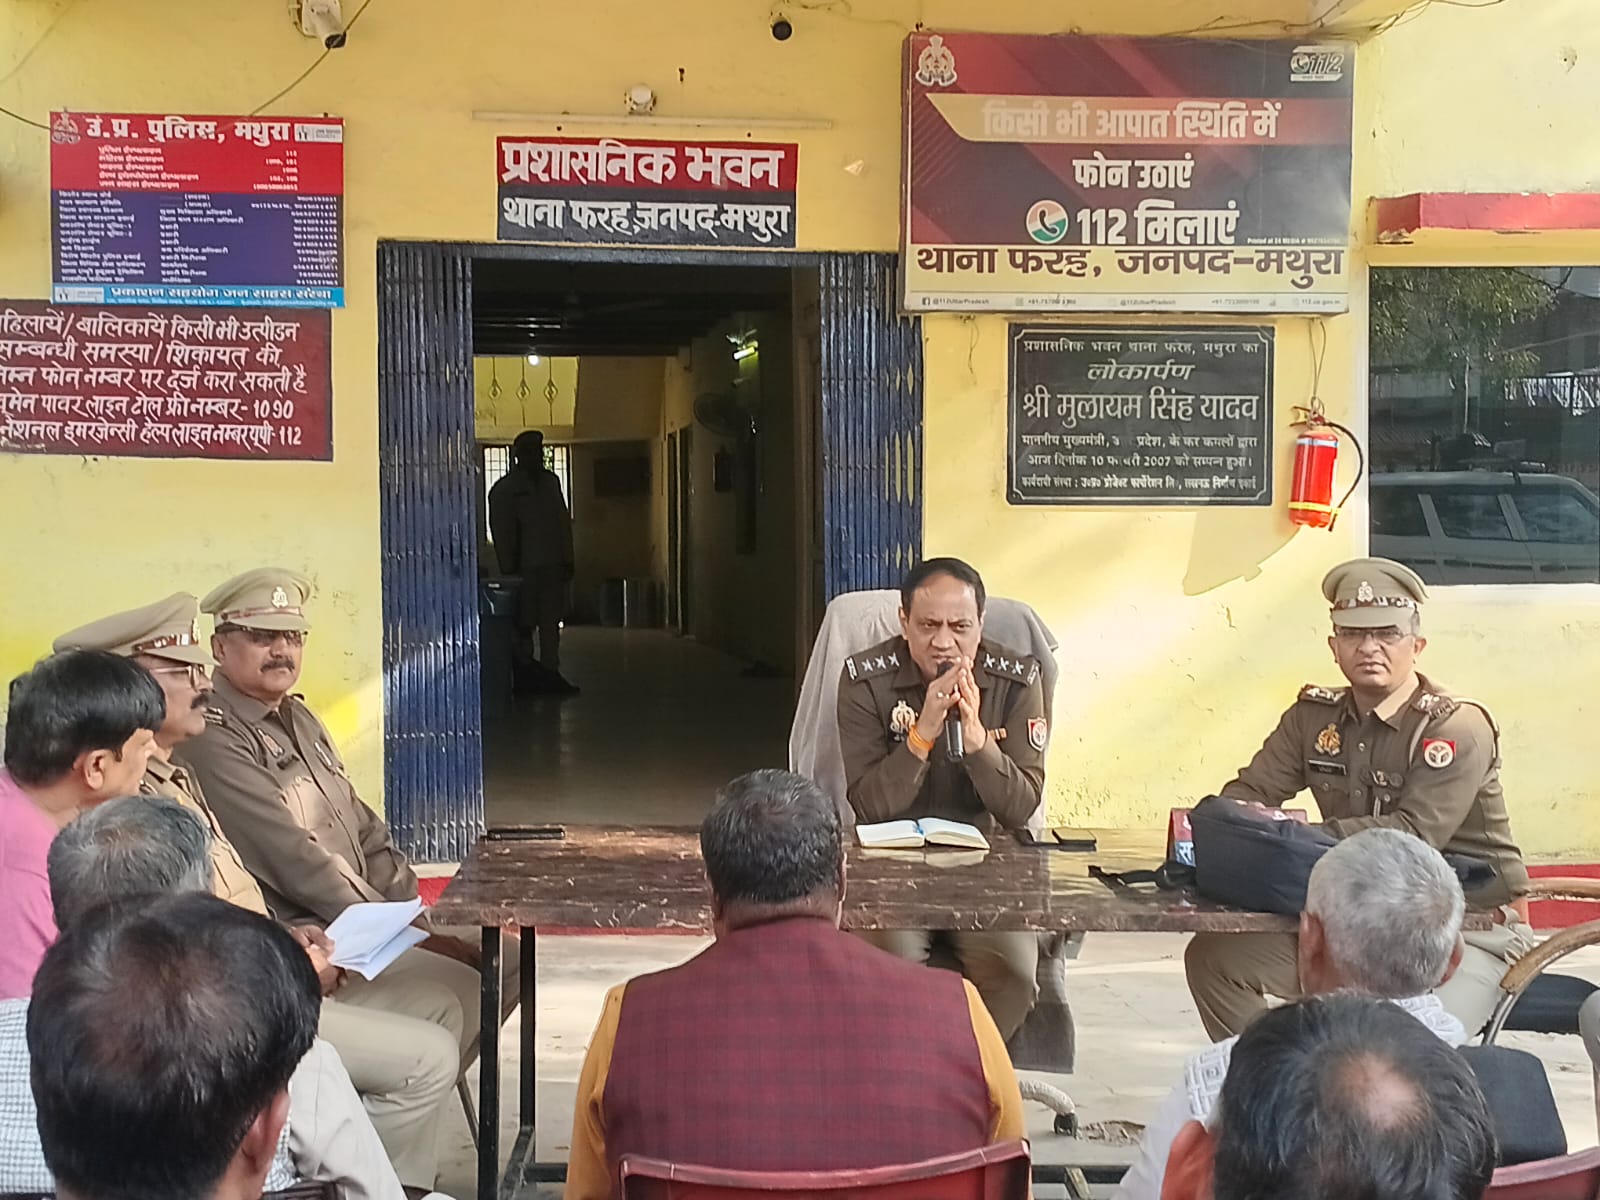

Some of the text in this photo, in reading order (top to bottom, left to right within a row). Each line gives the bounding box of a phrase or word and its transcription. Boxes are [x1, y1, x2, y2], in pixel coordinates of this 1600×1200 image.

[148, 116, 225, 144] पुलिस,
[235, 121, 290, 146] मथुरा
[982, 100, 1282, 139] किसी भी आपात स्थिति में
[502, 138, 784, 188] प्रशासनिक भवन
[1072, 151, 1194, 189] फोन उठाएं
[502, 196, 566, 229] थाना
[1076, 199, 1240, 245] 112 मिलाएं
[918, 247, 1344, 290] थाना फरह, जनपद-मथुरा
[77, 311, 167, 338] बालिकायें
[171, 314, 217, 342] किसी
[216, 315, 240, 341] भी
[256, 344, 283, 368] की
[1024, 337, 1084, 353] प्रशासनिक
[1091, 341, 1121, 353] भवन
[1203, 342, 1236, 358] मथुरा
[40, 361, 83, 389] फोन
[84, 367, 138, 393] नम्बर
[140, 368, 167, 394] पर
[166, 365, 201, 391] दर्ज
[203, 370, 237, 394] करा
[239, 366, 293, 398] सकती
[1087, 358, 1196, 382] लोकार्पण
[41, 394, 88, 418] पावर
[86, 394, 130, 419] लाइन
[131, 391, 164, 421] टोल
[253, 399, 294, 420] 1090
[1022, 384, 1260, 429] श्री मुलायम सिंह यादव
[0, 415, 63, 442] नेशनल
[279, 426, 302, 446] 112
[1022, 432, 1059, 447] माननीय
[1091, 456, 1104, 466] 10
[1143, 456, 1171, 467] 2007
